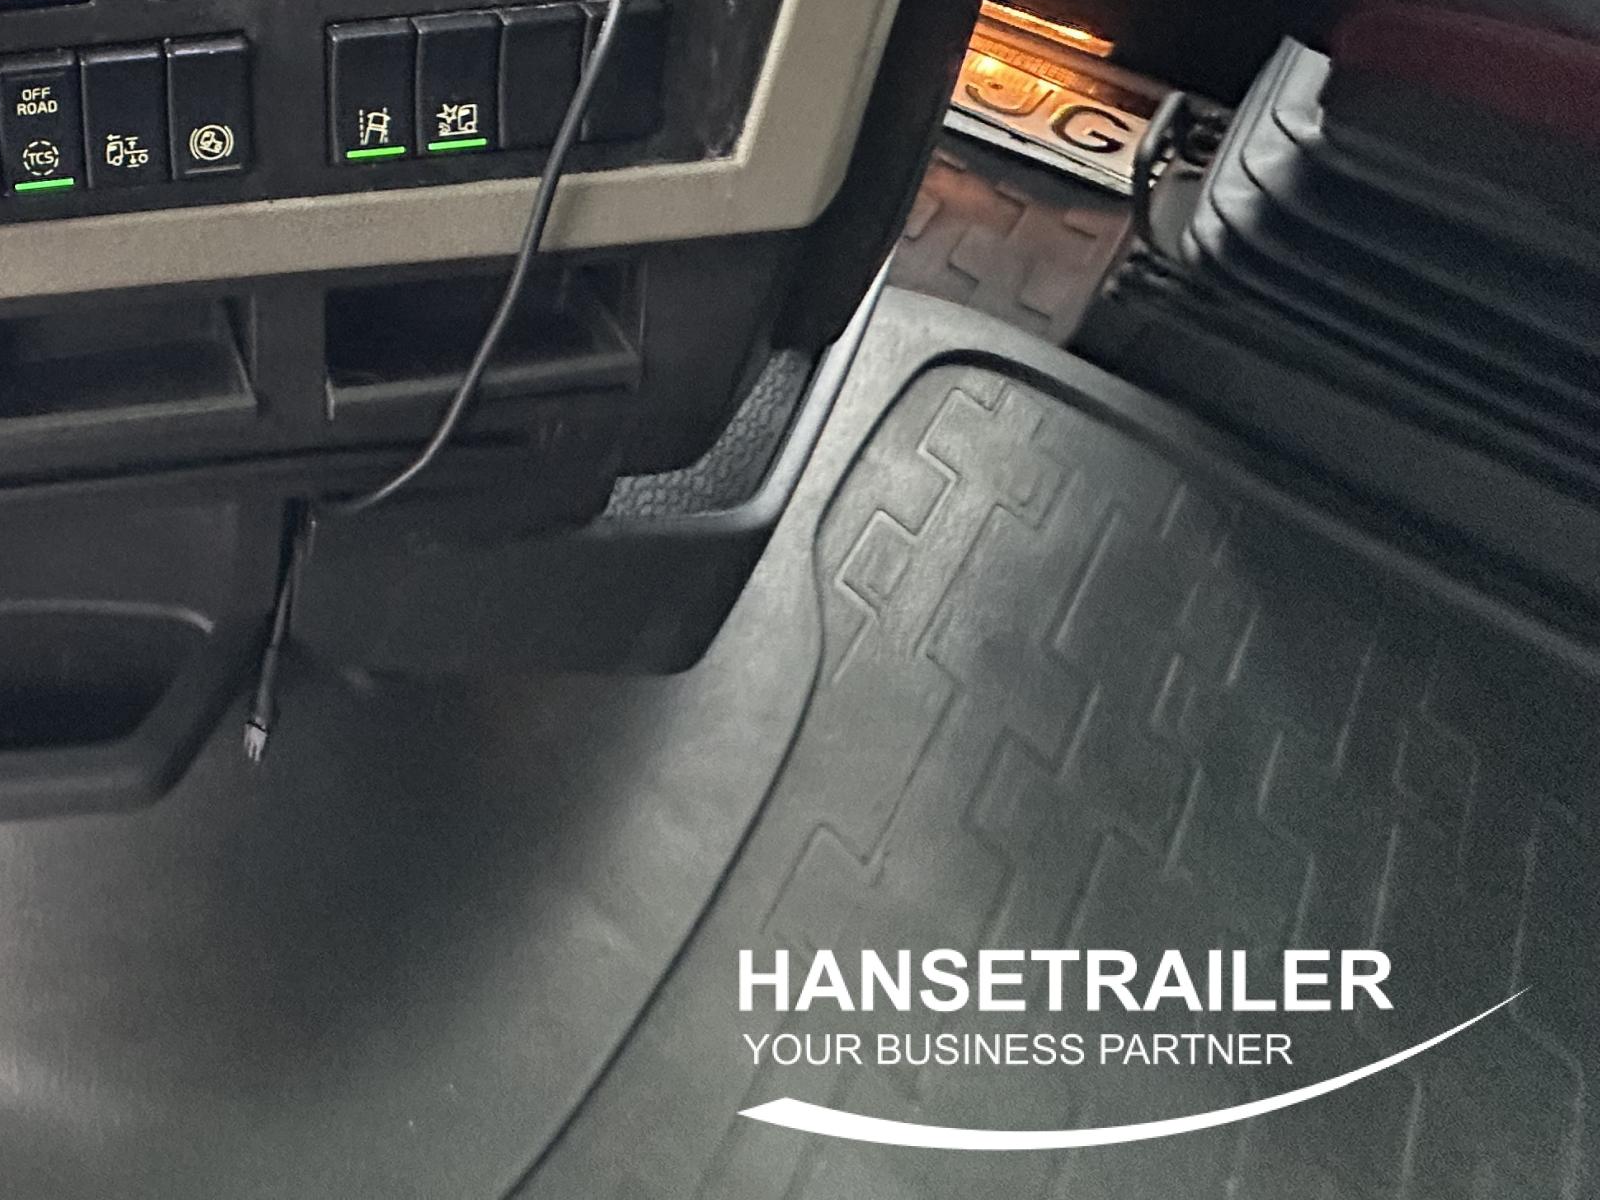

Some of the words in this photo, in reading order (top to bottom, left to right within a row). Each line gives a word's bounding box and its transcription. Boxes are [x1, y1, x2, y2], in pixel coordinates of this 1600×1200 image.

[21, 86, 51, 101] OFF
[16, 99, 58, 116] ROAD
[27, 150, 55, 166] TCS
